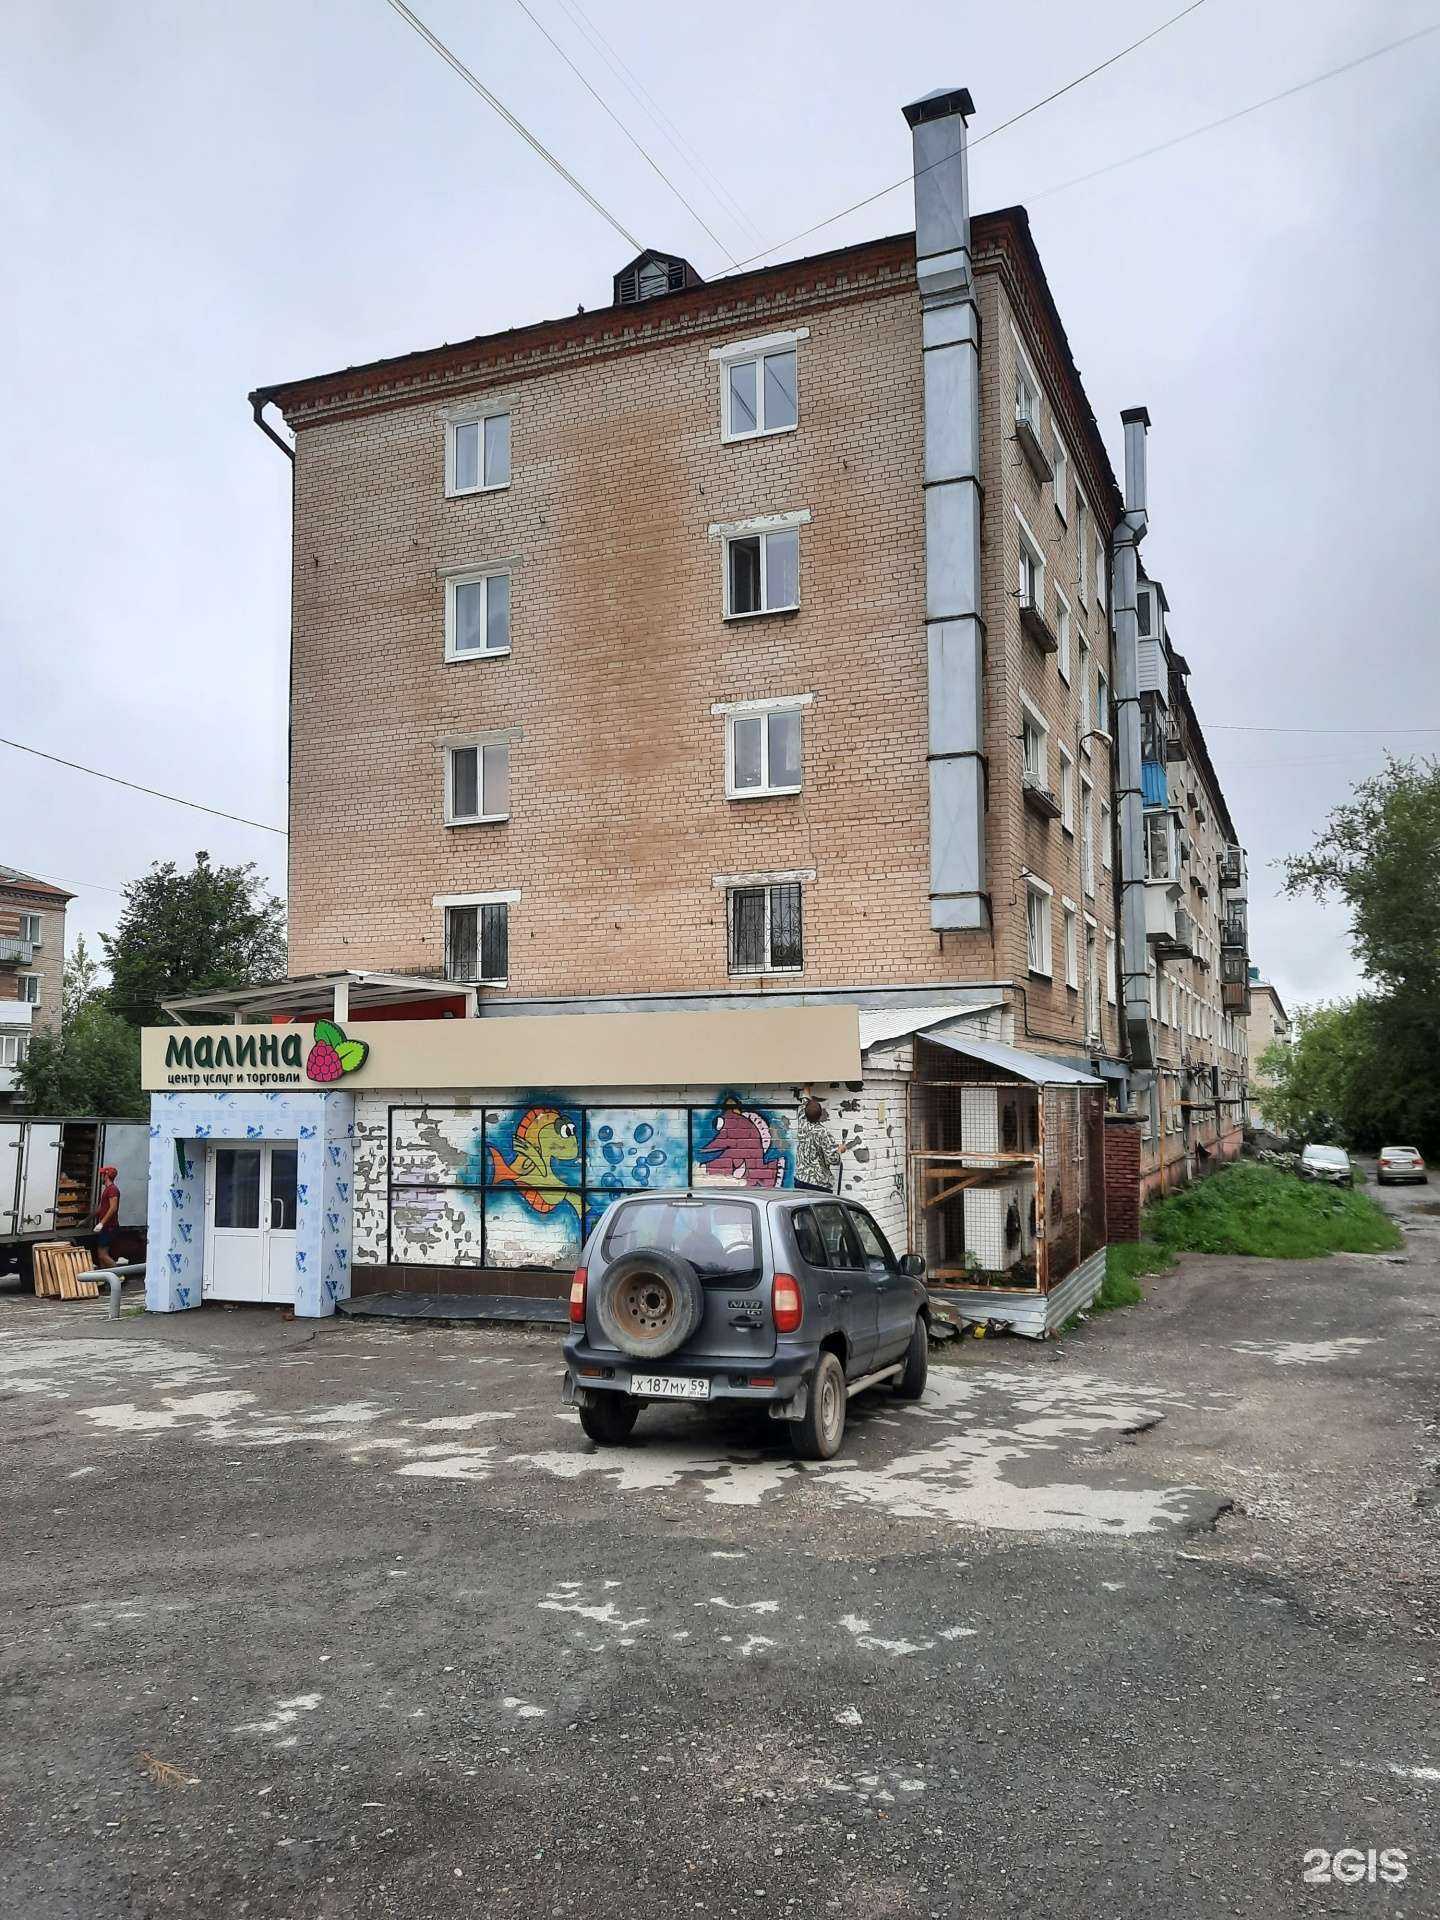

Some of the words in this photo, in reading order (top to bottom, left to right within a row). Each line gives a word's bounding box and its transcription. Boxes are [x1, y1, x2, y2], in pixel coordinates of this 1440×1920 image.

[168, 1074, 200, 1086] центр
[203, 1074, 233, 1086] услуг
[236, 1074, 244, 1083] и
[246, 1073, 300, 1085] торговли
